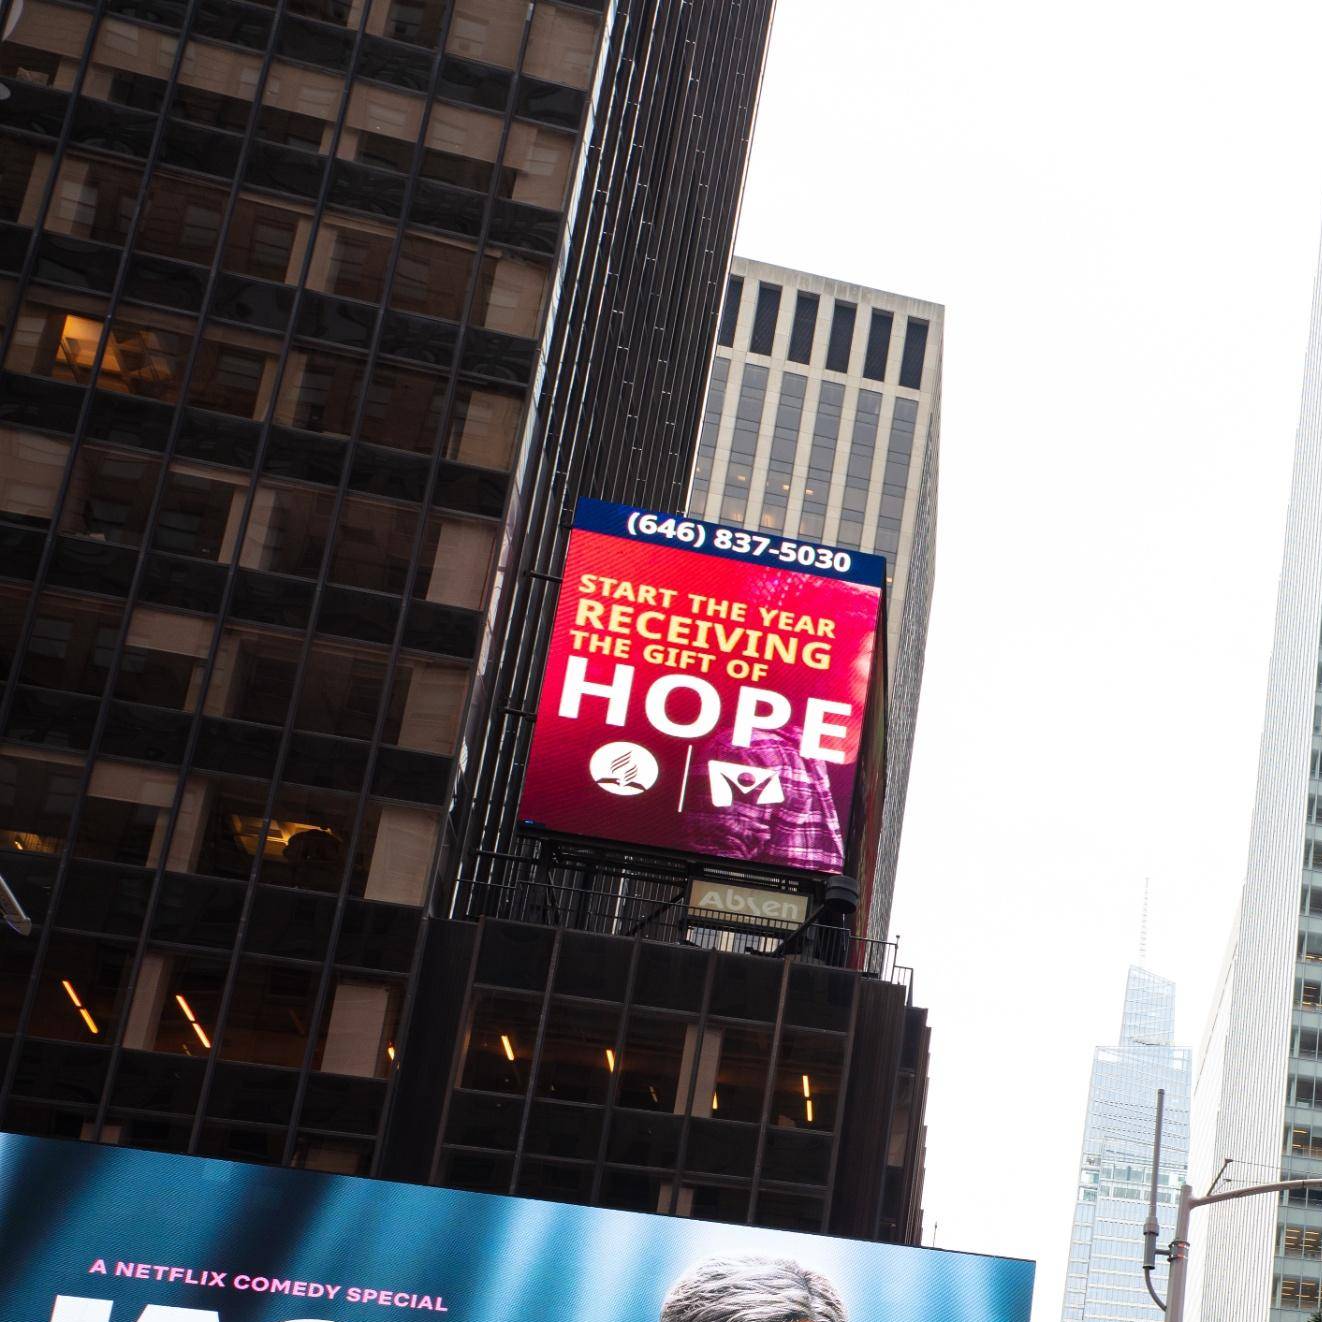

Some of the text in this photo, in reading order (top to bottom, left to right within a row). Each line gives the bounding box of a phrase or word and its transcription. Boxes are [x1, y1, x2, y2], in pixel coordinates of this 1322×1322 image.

[627, 512, 851, 572] (646) 837-5030
[575, 599, 832, 669] RECEIVING
[579, 574, 835, 638] START THE YEAR
[570, 630, 768, 682] THE GIFT OF
[558, 656, 852, 764] HOPE
[89, 1259, 448, 1312] A NETFLIX COMEDY SPECIAL
